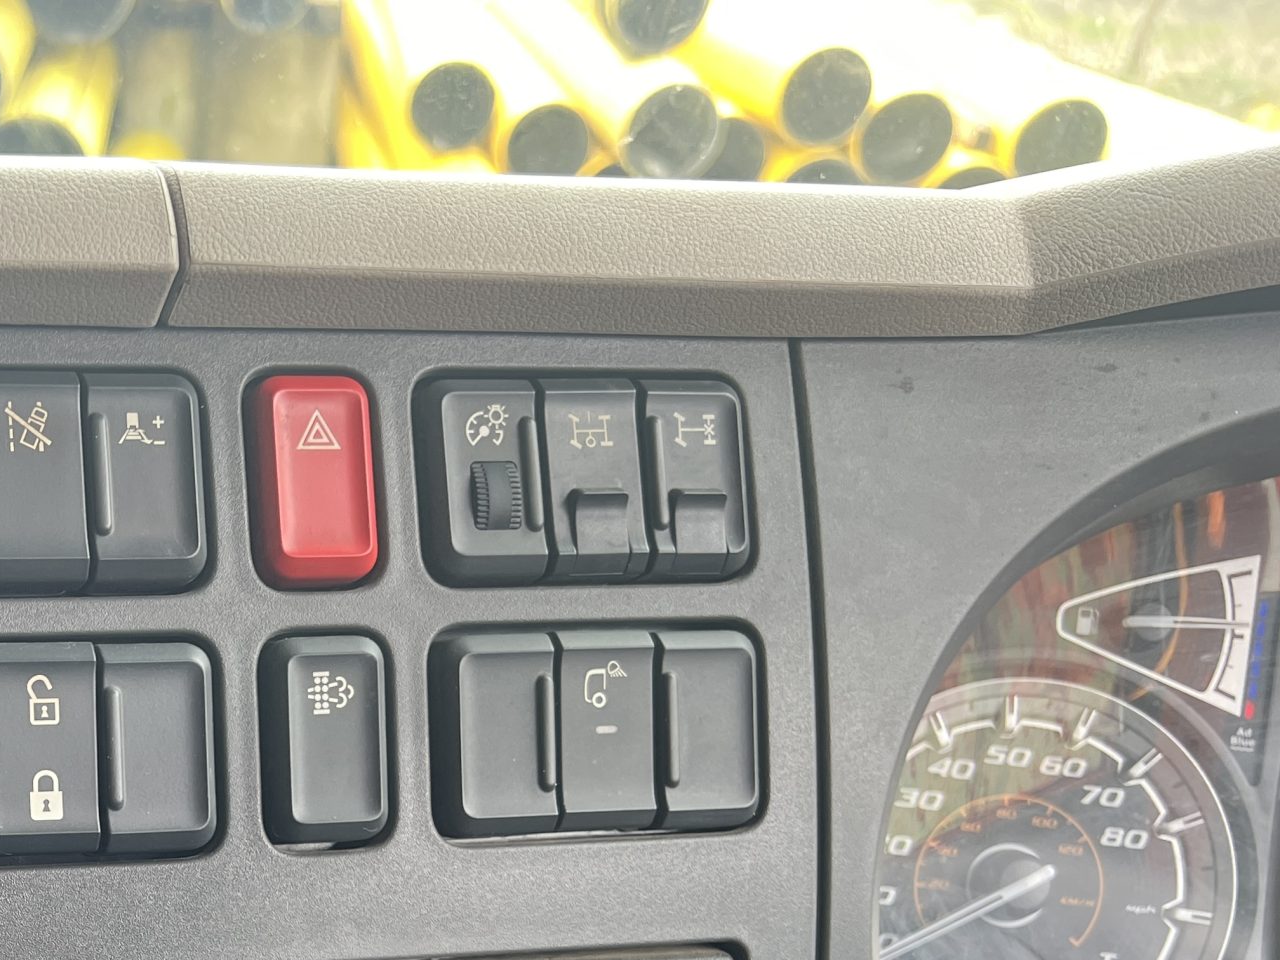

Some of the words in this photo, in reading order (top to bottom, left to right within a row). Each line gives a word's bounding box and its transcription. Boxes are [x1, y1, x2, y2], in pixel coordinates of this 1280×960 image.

[984, 744, 1032, 768] 50
[1039, 756, 1087, 778] 60
[927, 758, 975, 780] 40
[894, 787, 944, 811] 30
[1080, 784, 1125, 808] 70
[883, 834, 913, 857] 0
[1099, 826, 1149, 850] 80
